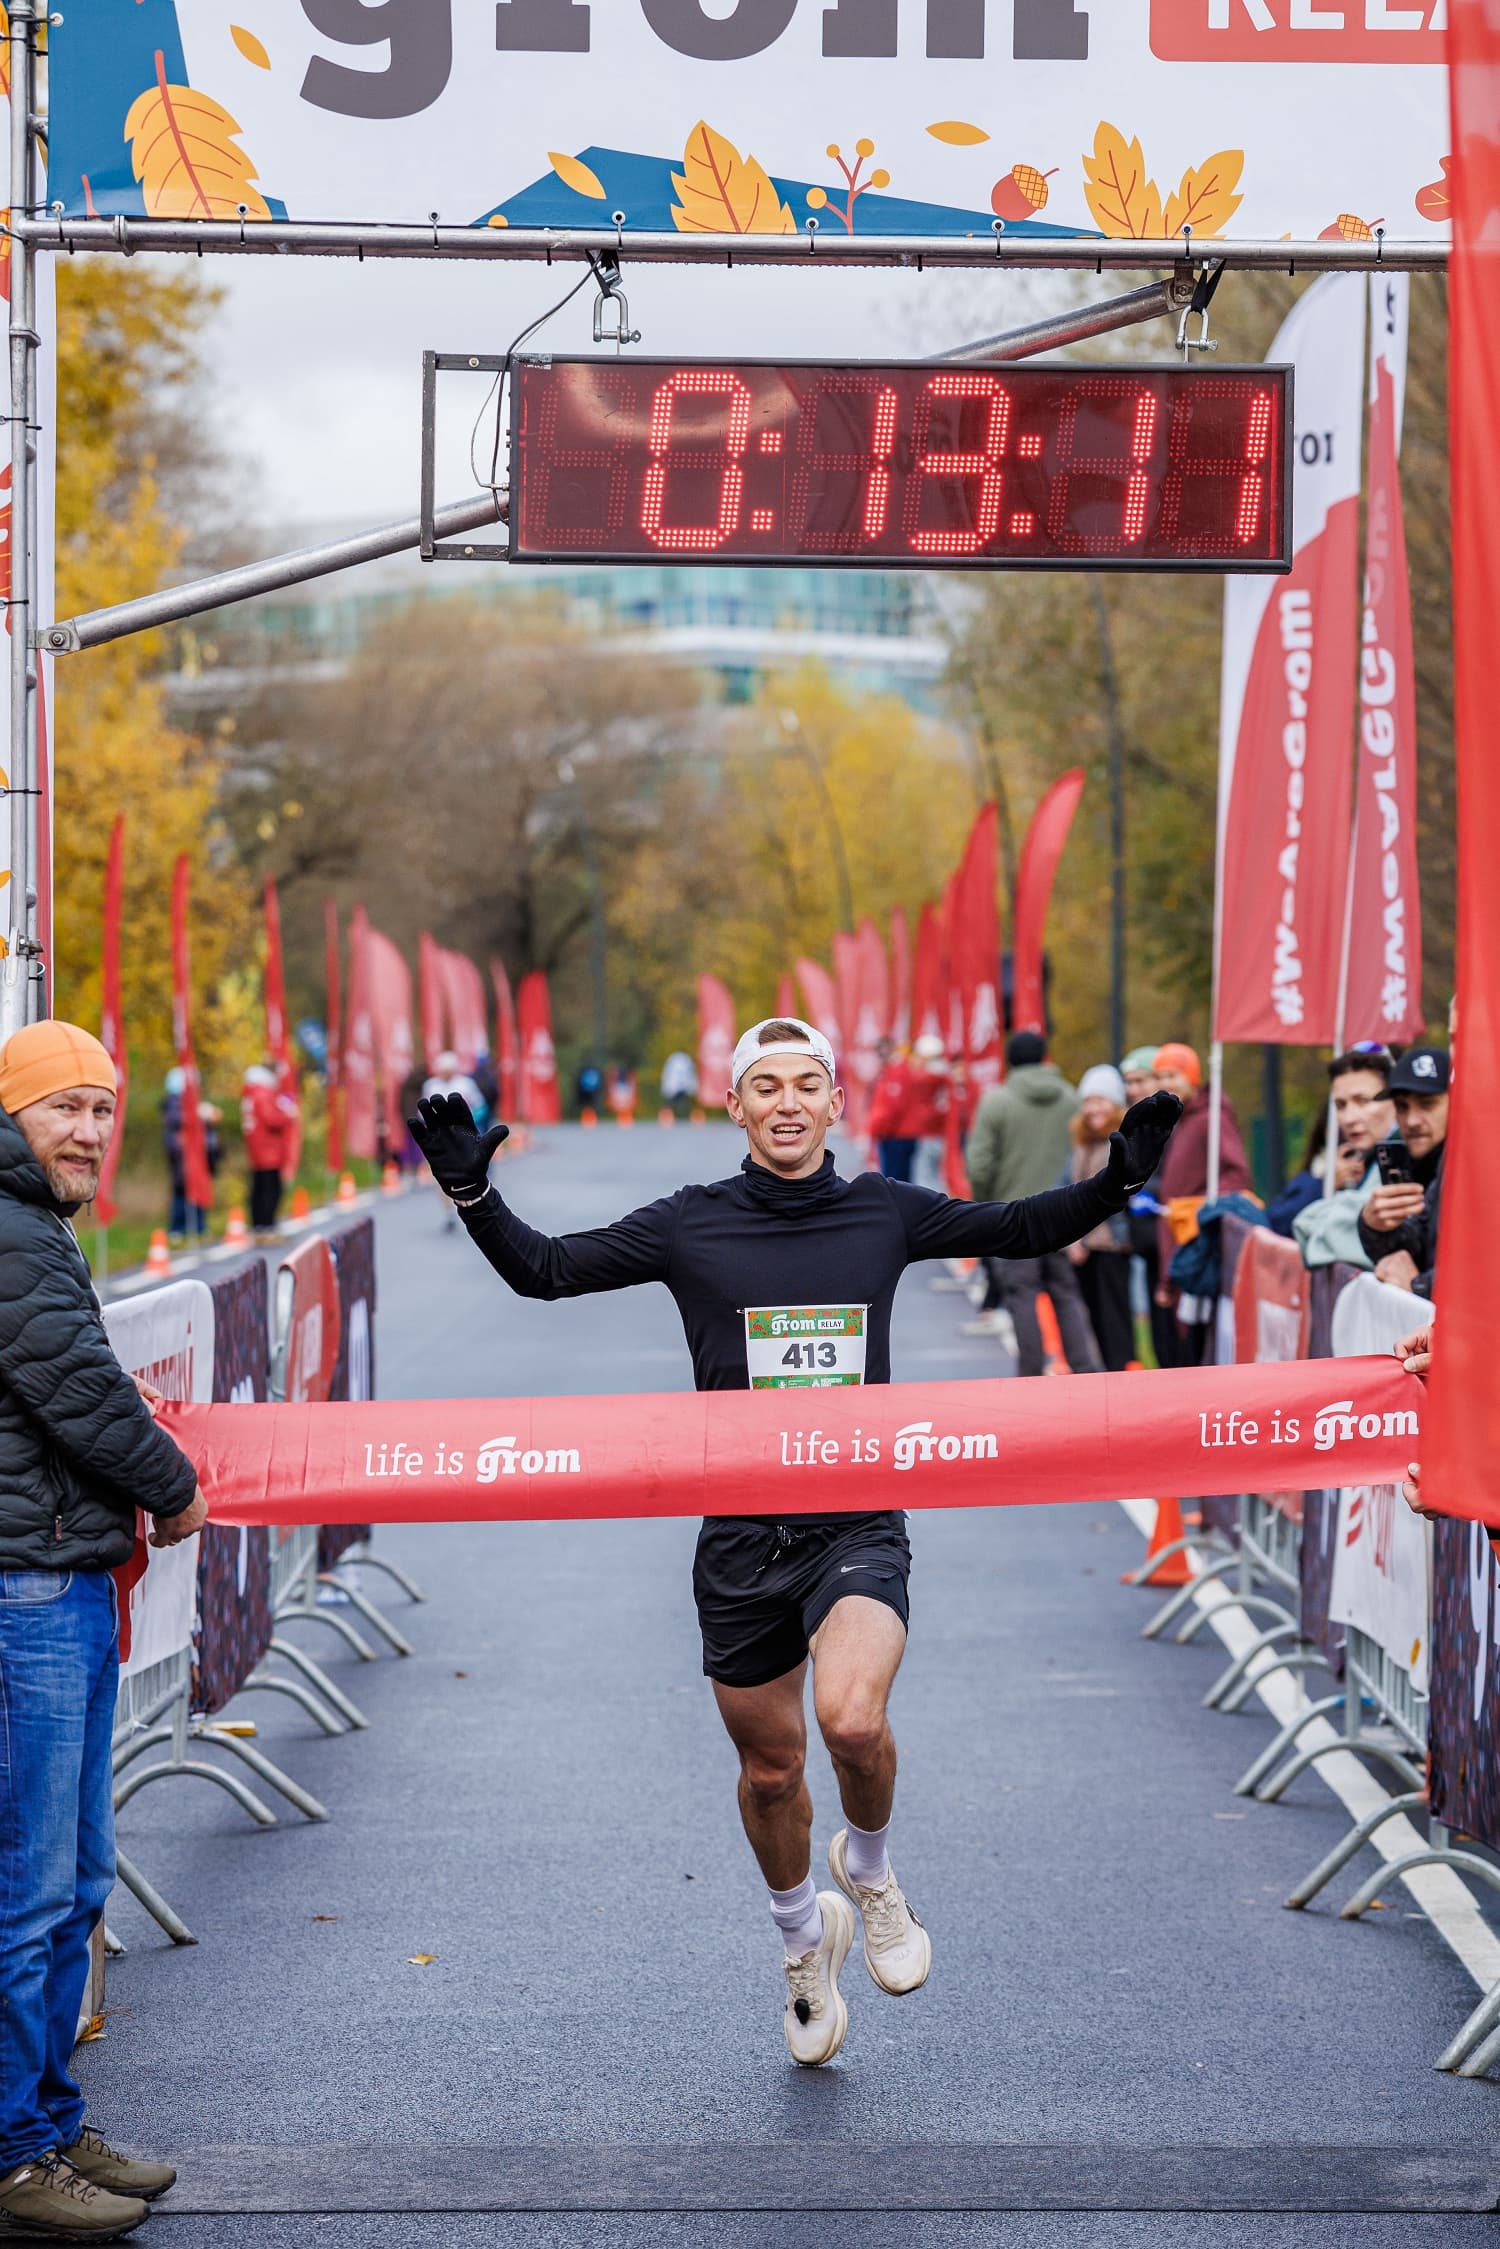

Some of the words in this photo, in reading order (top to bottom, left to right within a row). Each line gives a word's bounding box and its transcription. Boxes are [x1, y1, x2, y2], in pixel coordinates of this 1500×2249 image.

[641, 372, 1271, 551] 0:13:11
[771, 1313, 817, 1336] grom
[820, 1320, 843, 1329] RELAY
[781, 1342, 838, 1369] 413
[779, 1430, 840, 1466] life
[849, 1428, 881, 1463] is
[893, 1421, 999, 1471] grom
[1198, 1410, 1260, 1448] life
[1269, 1408, 1301, 1444] is
[1313, 1400, 1420, 1451] grom
[363, 1442, 424, 1477] life
[433, 1442, 465, 1475] is
[475, 1436, 581, 1484] grom
